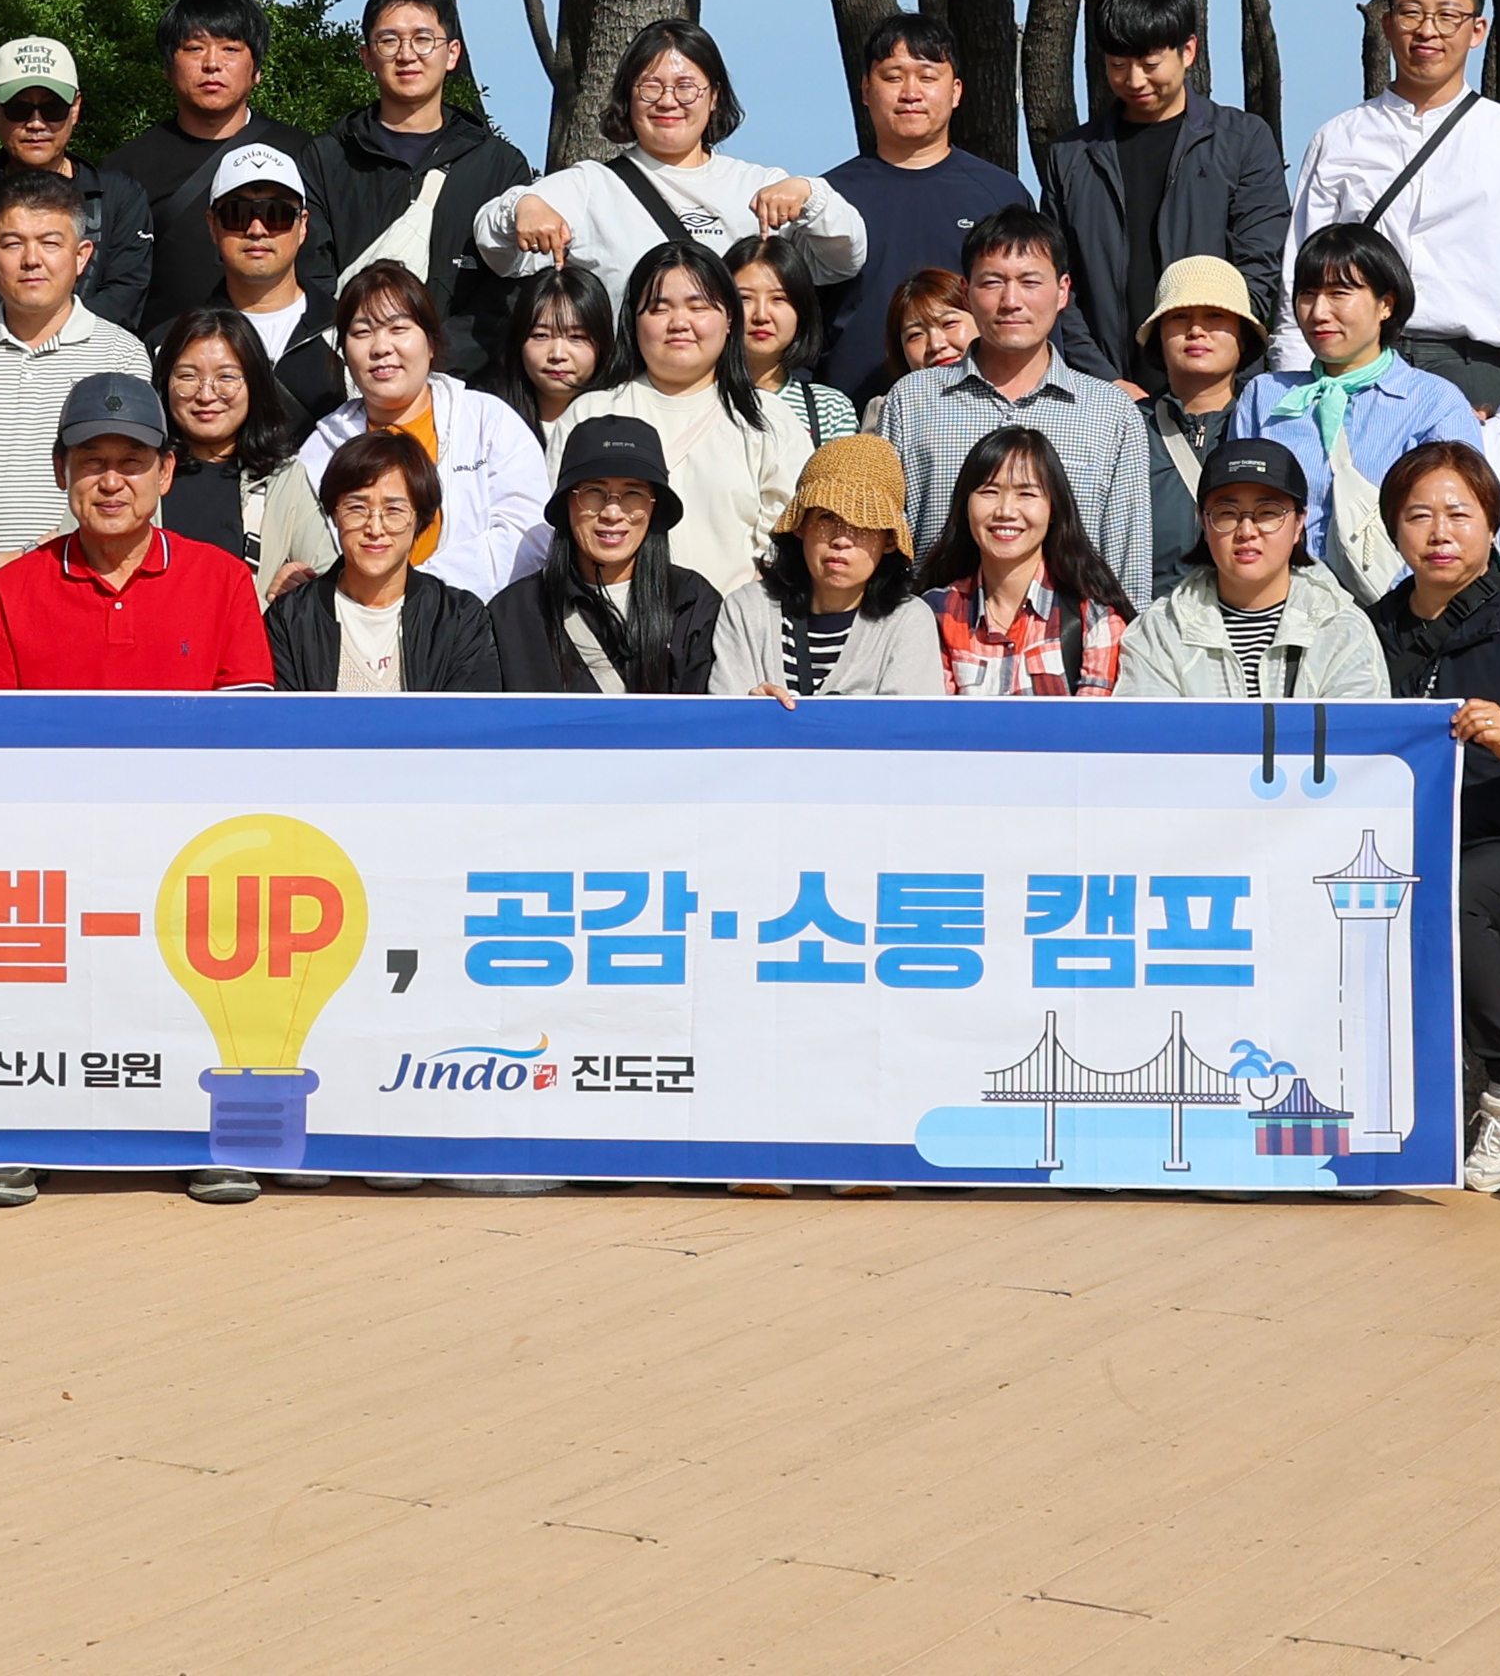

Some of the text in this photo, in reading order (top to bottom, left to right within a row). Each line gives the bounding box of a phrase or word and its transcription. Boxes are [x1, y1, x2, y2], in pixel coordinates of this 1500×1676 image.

[14, 55, 57, 67] Windy
[18, 44, 53, 56] Misty
[21, 64, 51, 74] Jeju
[233, 150, 285, 167] Callaway
[464, 871, 986, 989] 공감·소통
[1024, 874, 1255, 988] 캠프
[80, 1052, 162, 1089] 일원
[378, 1052, 528, 1093] Jindo
[571, 1055, 695, 1094] 진도군
